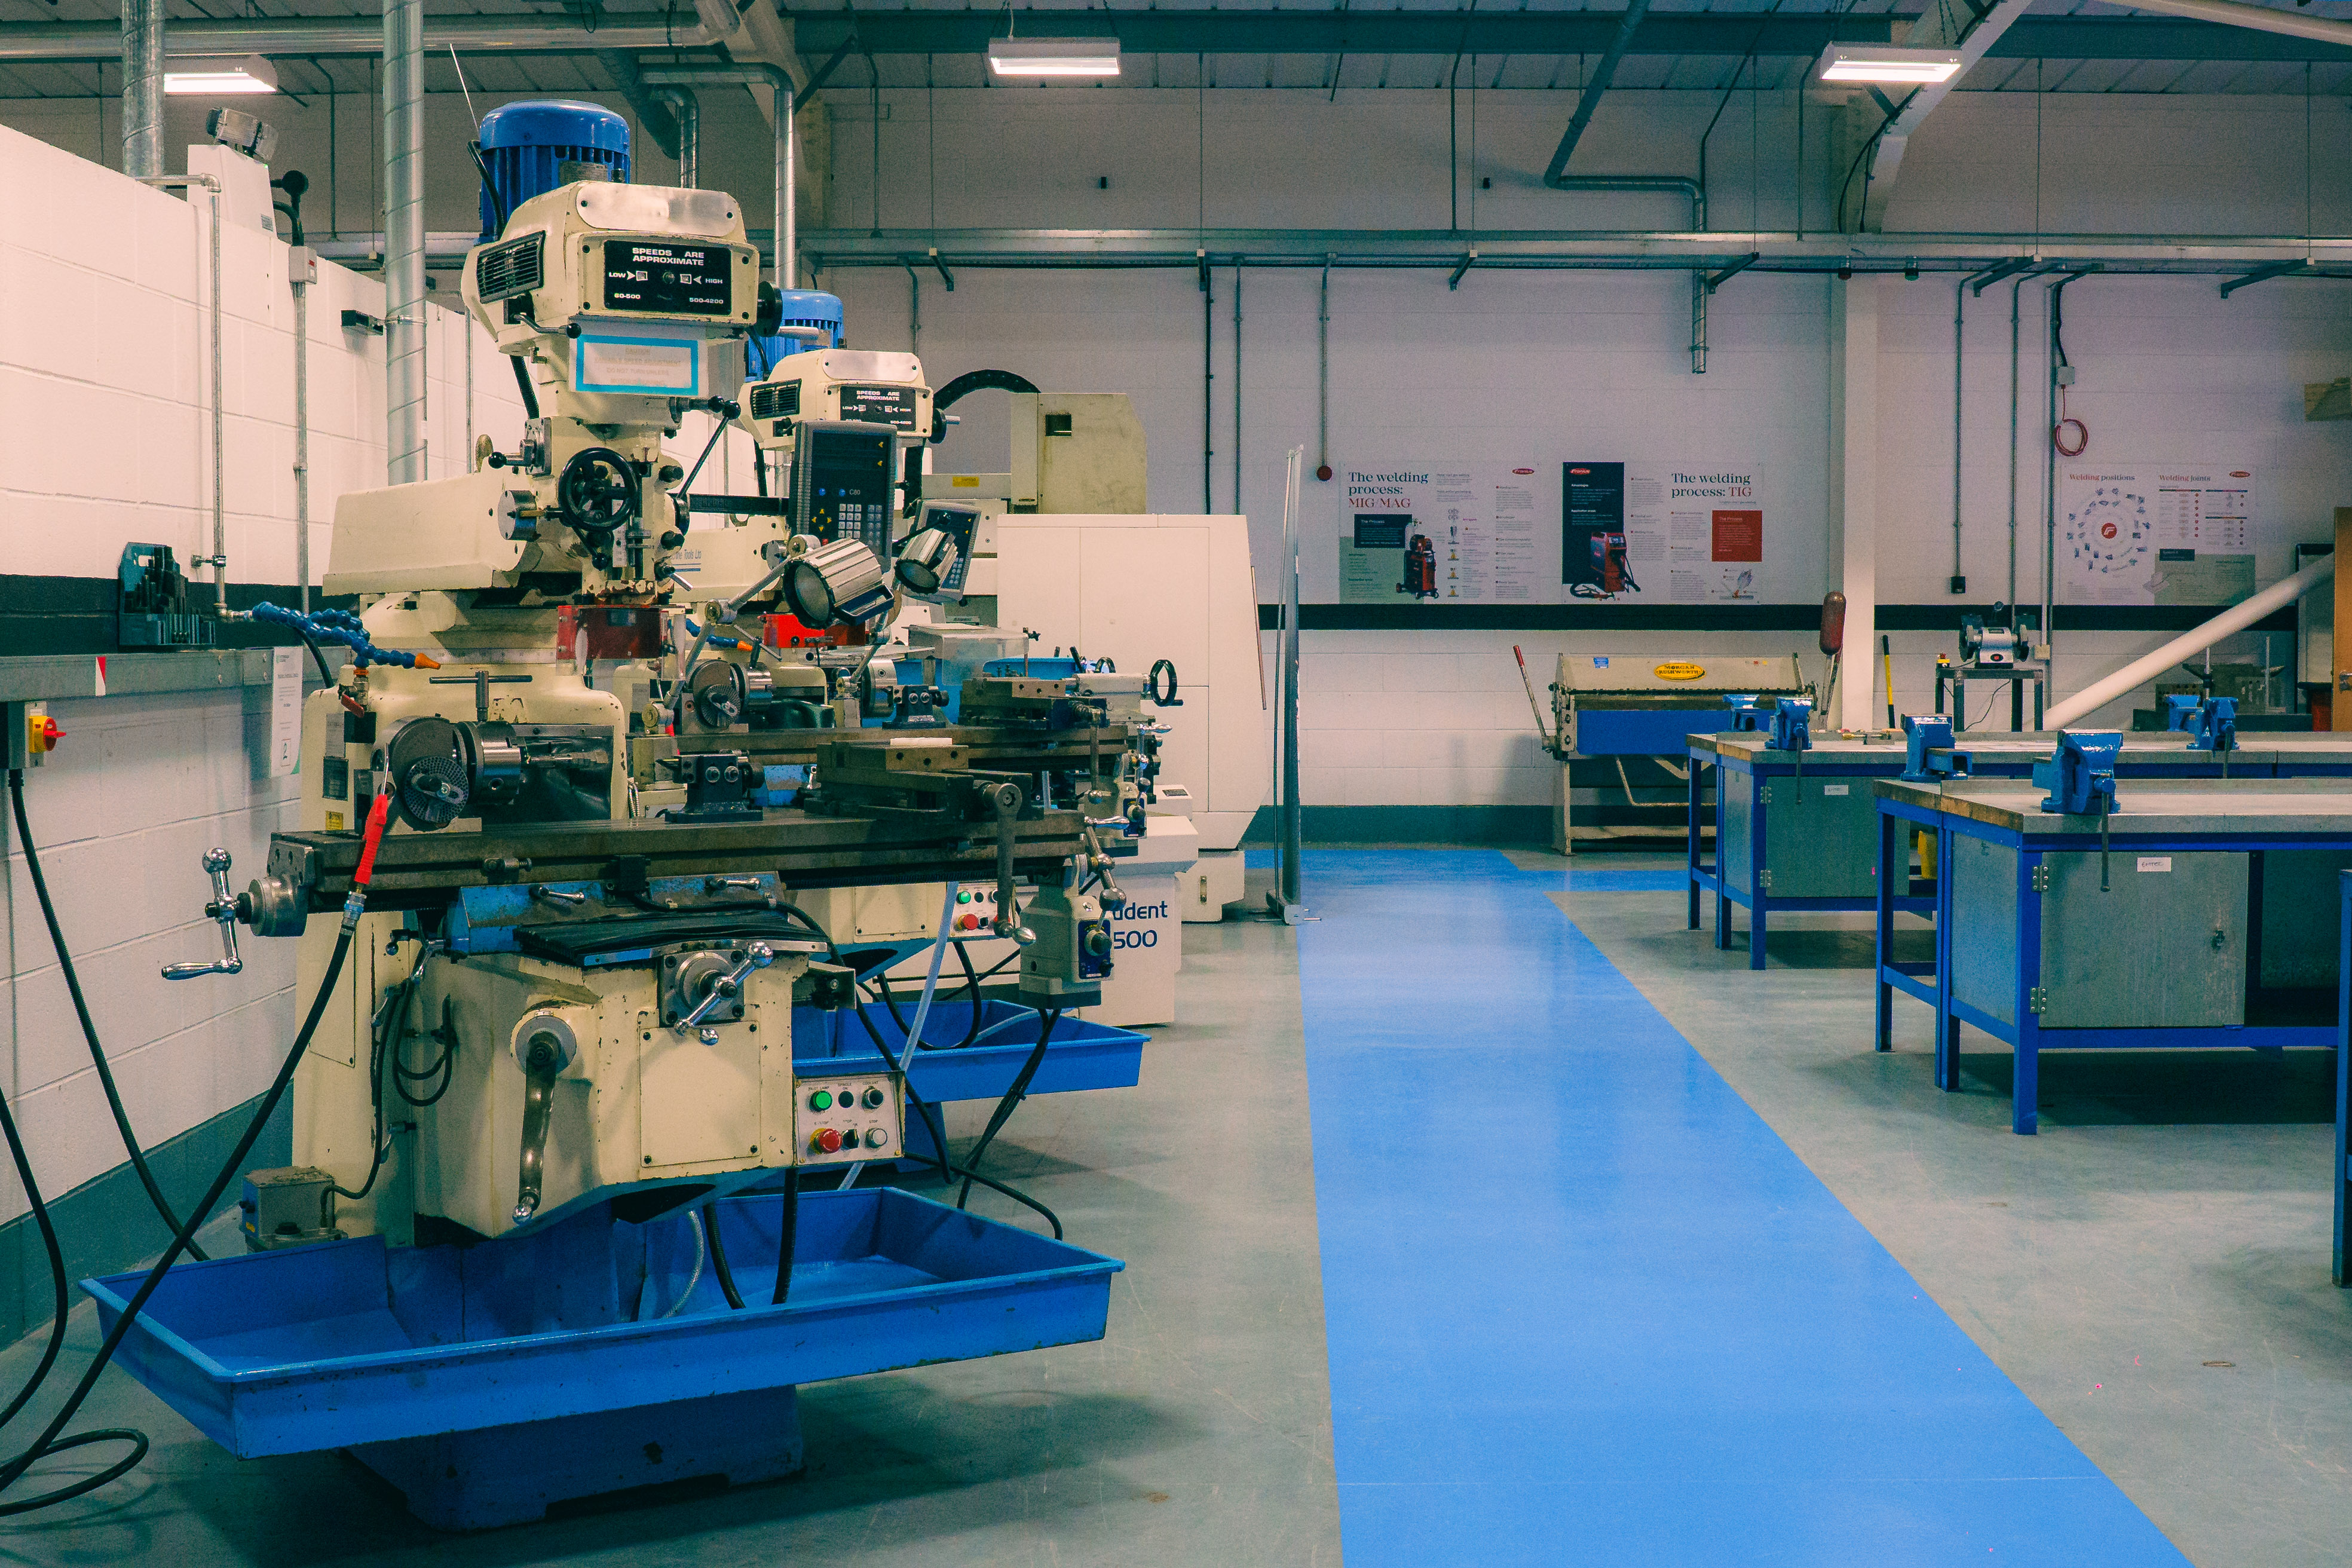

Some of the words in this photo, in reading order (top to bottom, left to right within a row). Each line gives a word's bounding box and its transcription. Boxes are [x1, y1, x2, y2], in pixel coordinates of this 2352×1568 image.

[632, 247, 672, 256] SPEEDS
[632, 255, 705, 266] APPROXIMATE
[1348, 472, 1373, 482] The
[1376, 472, 1429, 484] welding
[1671, 473, 1696, 483] The
[1699, 473, 1751, 485] welding
[1348, 486, 1403, 496] process:
[1671, 488, 1726, 498] process:
[1729, 486, 1751, 497] TIG
[1113, 901, 1168, 920] udent
